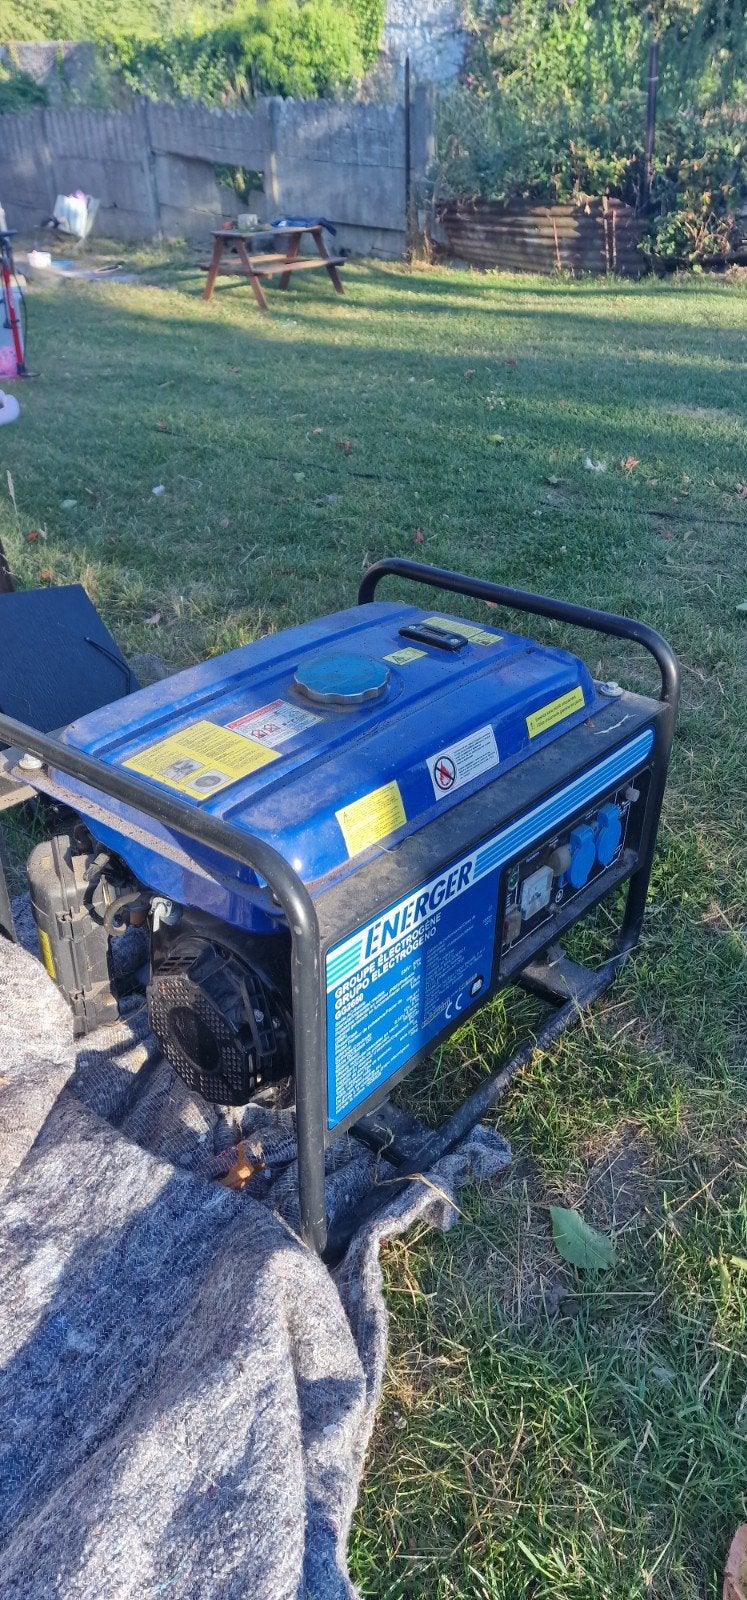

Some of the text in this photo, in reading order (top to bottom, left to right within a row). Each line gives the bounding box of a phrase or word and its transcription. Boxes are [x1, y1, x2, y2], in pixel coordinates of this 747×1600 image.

[365, 861, 472, 959] ENERGER
[335, 912, 441, 998] GROUPE ÉLECTROGÈNE
[335, 980, 370, 1010] GRUPO
